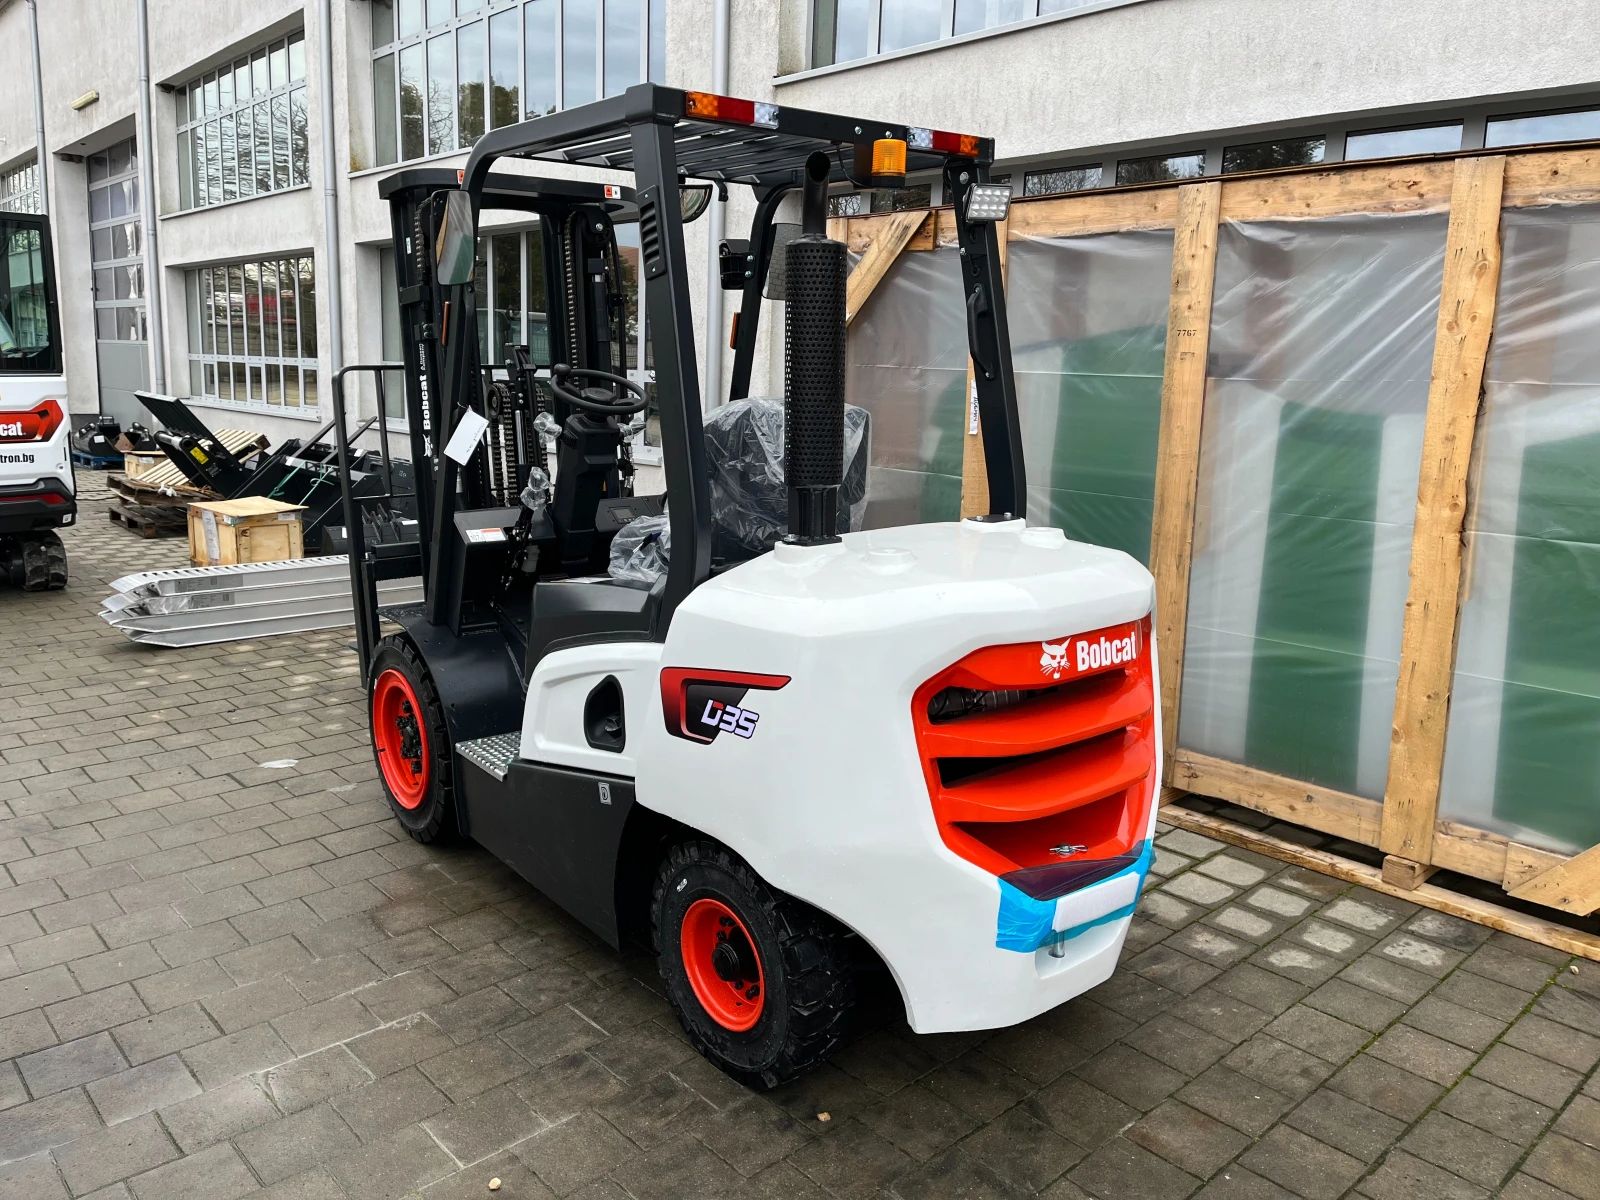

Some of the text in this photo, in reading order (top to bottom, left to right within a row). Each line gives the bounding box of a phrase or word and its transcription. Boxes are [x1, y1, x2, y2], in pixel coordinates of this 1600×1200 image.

[1177, 329, 1197, 337] 7767
[420, 375, 431, 430] Bobcat
[1076, 631, 1137, 672] Bobcat
